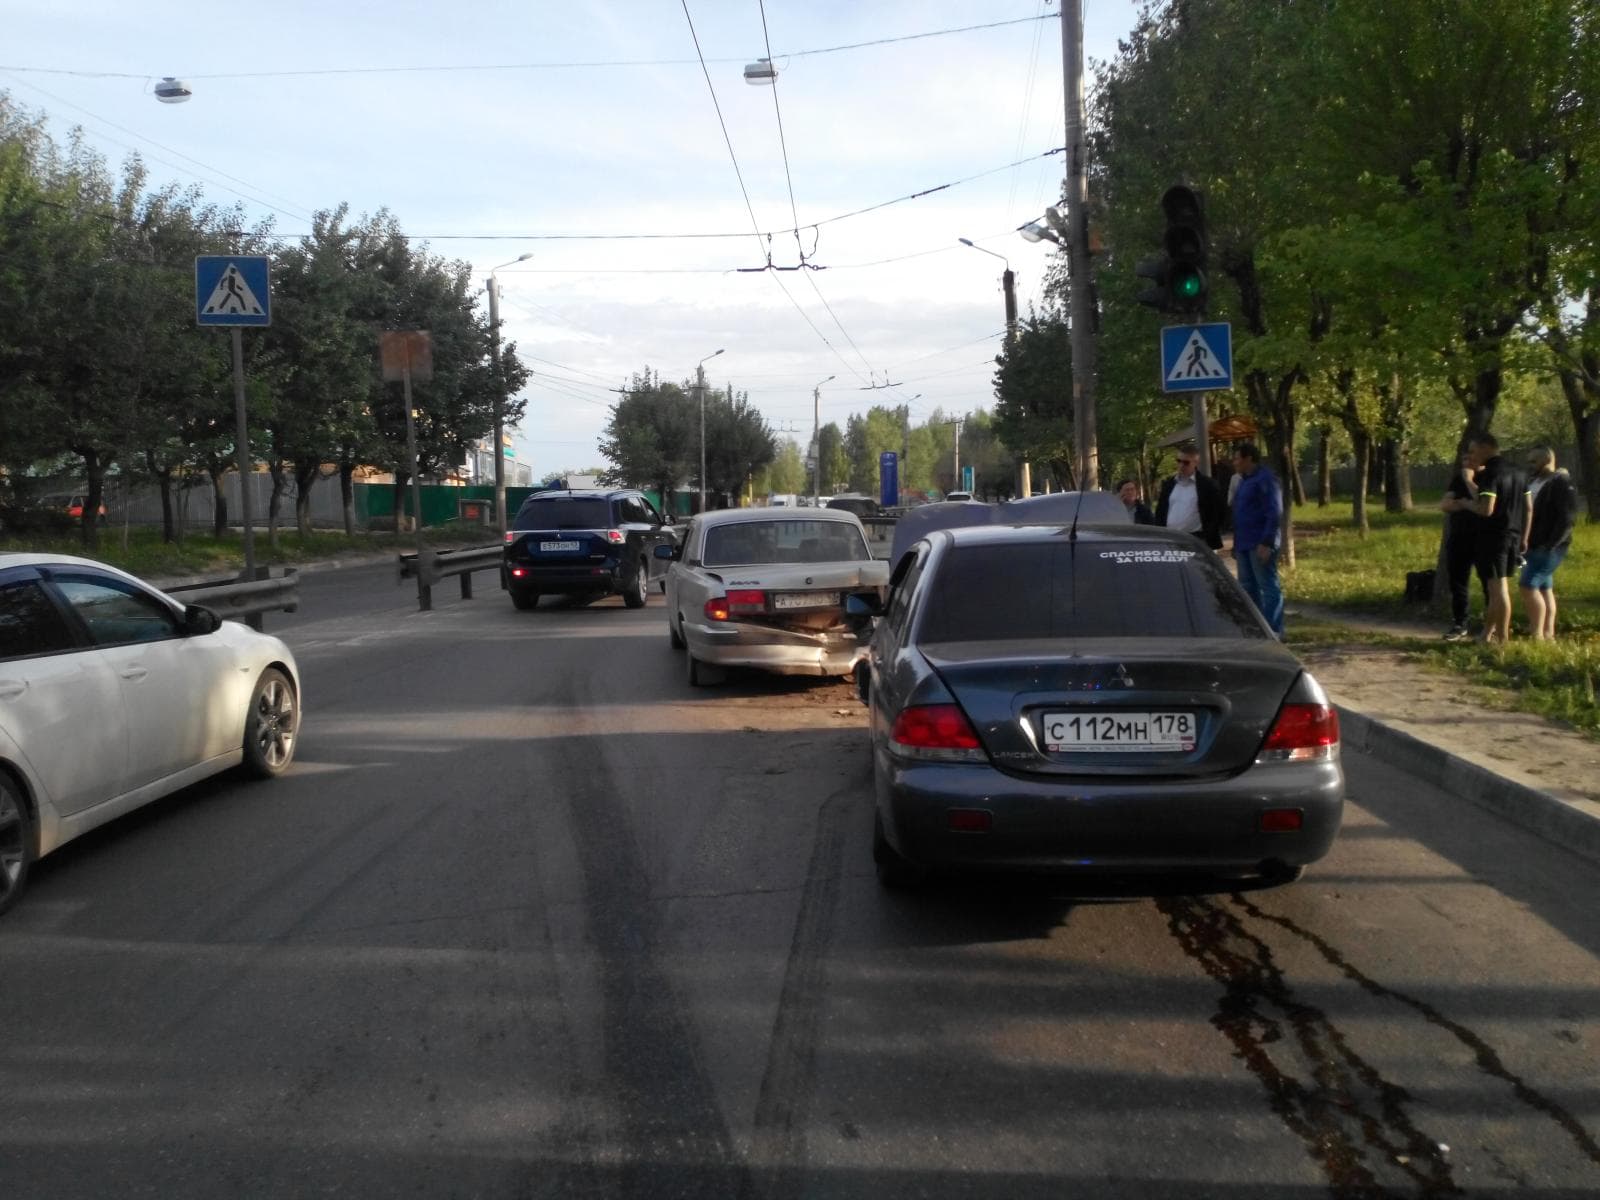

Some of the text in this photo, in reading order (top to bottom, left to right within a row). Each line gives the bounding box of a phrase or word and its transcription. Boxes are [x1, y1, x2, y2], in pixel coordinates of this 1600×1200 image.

[1099, 550, 1161, 558] СПАСИБО
[1050, 715, 1189, 741] С112МН 178
